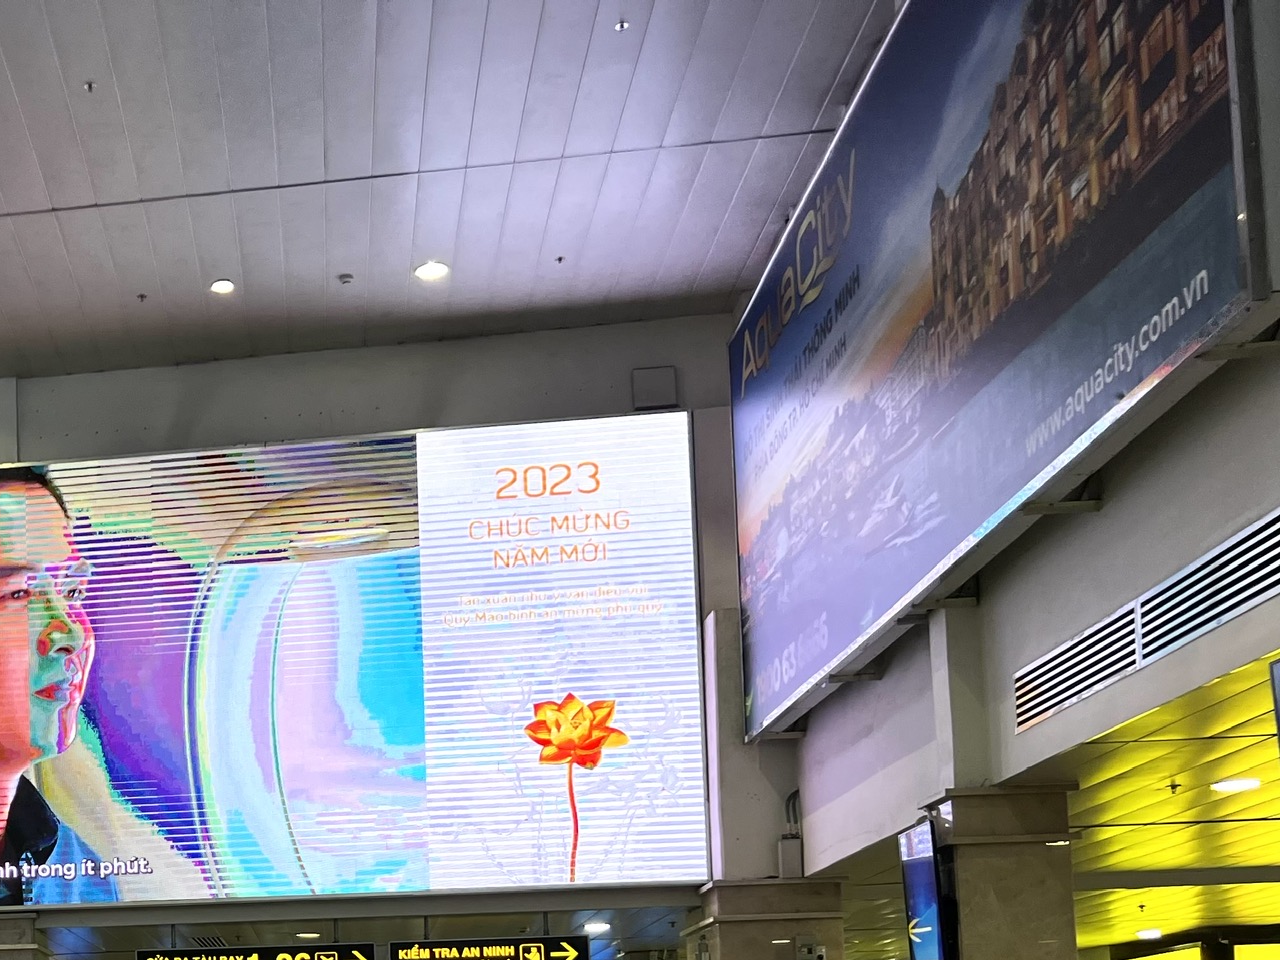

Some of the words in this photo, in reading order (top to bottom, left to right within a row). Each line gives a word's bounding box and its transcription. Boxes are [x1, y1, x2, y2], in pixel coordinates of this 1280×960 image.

[835, 263, 861, 321] MINH
[1025, 269, 1209, 458] www.aquacity.com.vn
[495, 462, 601, 499] 2023
[469, 513, 540, 540] CHÚC
[551, 508, 630, 533] MỪNG
[493, 544, 550, 568] NĂM
[559, 538, 607, 563] MỚI
[22, 862, 75, 882] trong
[81, 859, 95, 877] ít
[100, 857, 153, 878] phút.
[398, 944, 430, 959] KIỂM
[432, 947, 459, 958] TRA
[461, 946, 480, 957] AN
[483, 945, 515, 957] NINH
